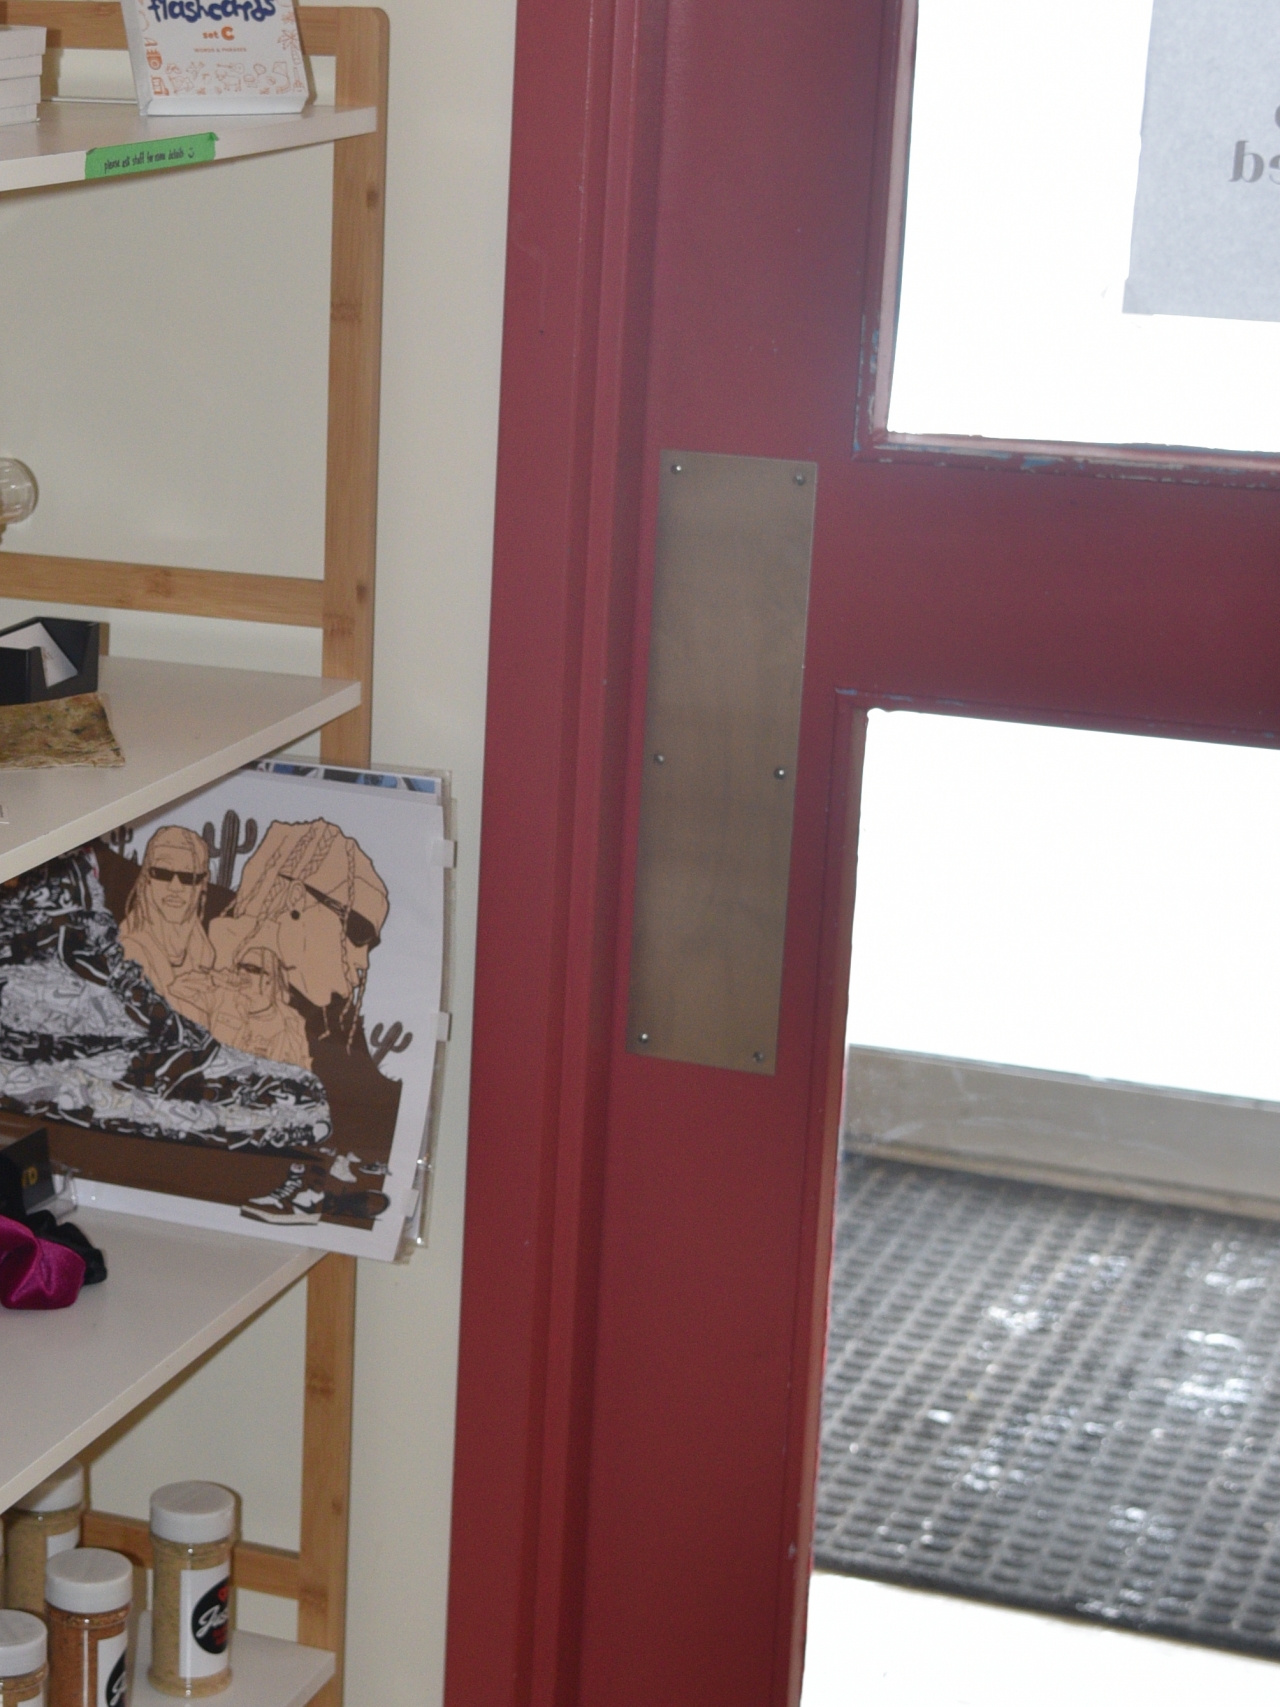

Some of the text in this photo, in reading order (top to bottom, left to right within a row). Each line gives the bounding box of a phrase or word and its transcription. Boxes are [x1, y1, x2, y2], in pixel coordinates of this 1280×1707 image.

[202, 26, 235, 41] set C
[104, 159, 120, 174] please
